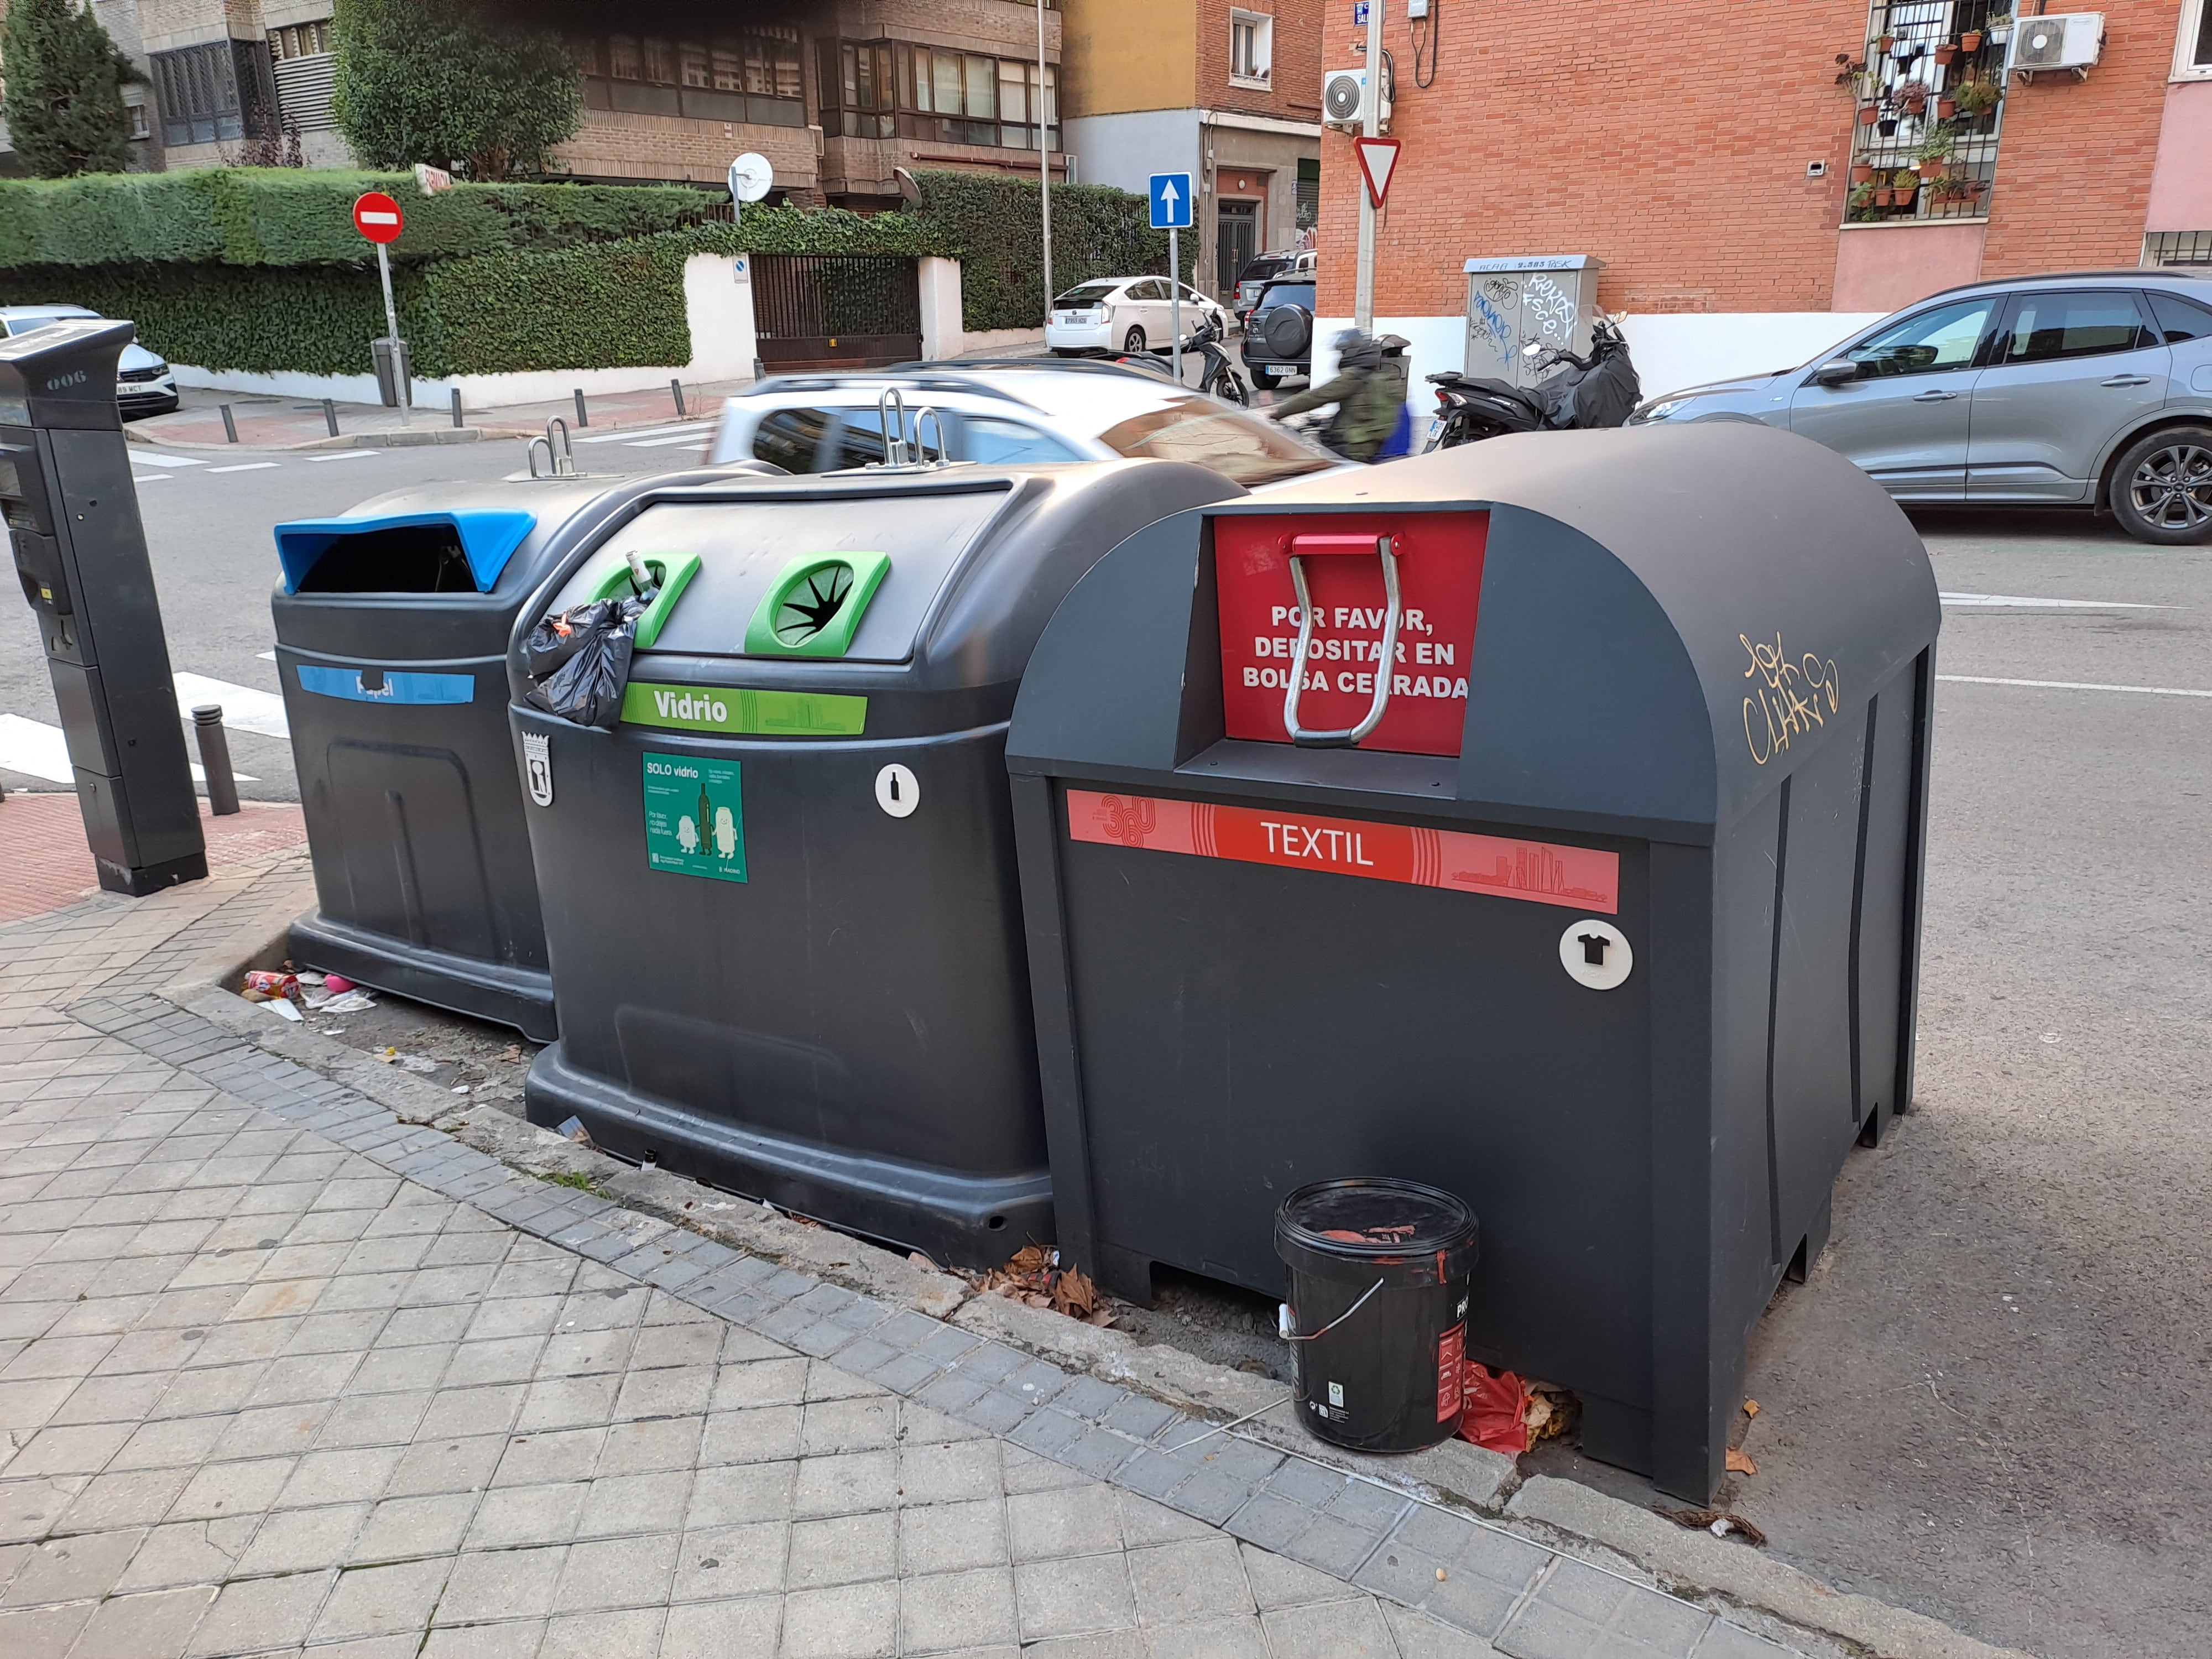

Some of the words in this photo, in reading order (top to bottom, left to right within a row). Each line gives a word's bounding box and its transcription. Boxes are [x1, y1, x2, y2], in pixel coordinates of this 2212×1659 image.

[1271, 606, 1327, 628] POR
[1416, 643, 1455, 665] EN
[1337, 672, 1469, 700] CERADA
[654, 690, 727, 723] Vidrio
[646, 762, 672, 775] SOLO
[674, 765, 698, 779] vidrio
[1260, 821, 1374, 866] TEXTIL
[1457, 1296, 1469, 1318] PRO
